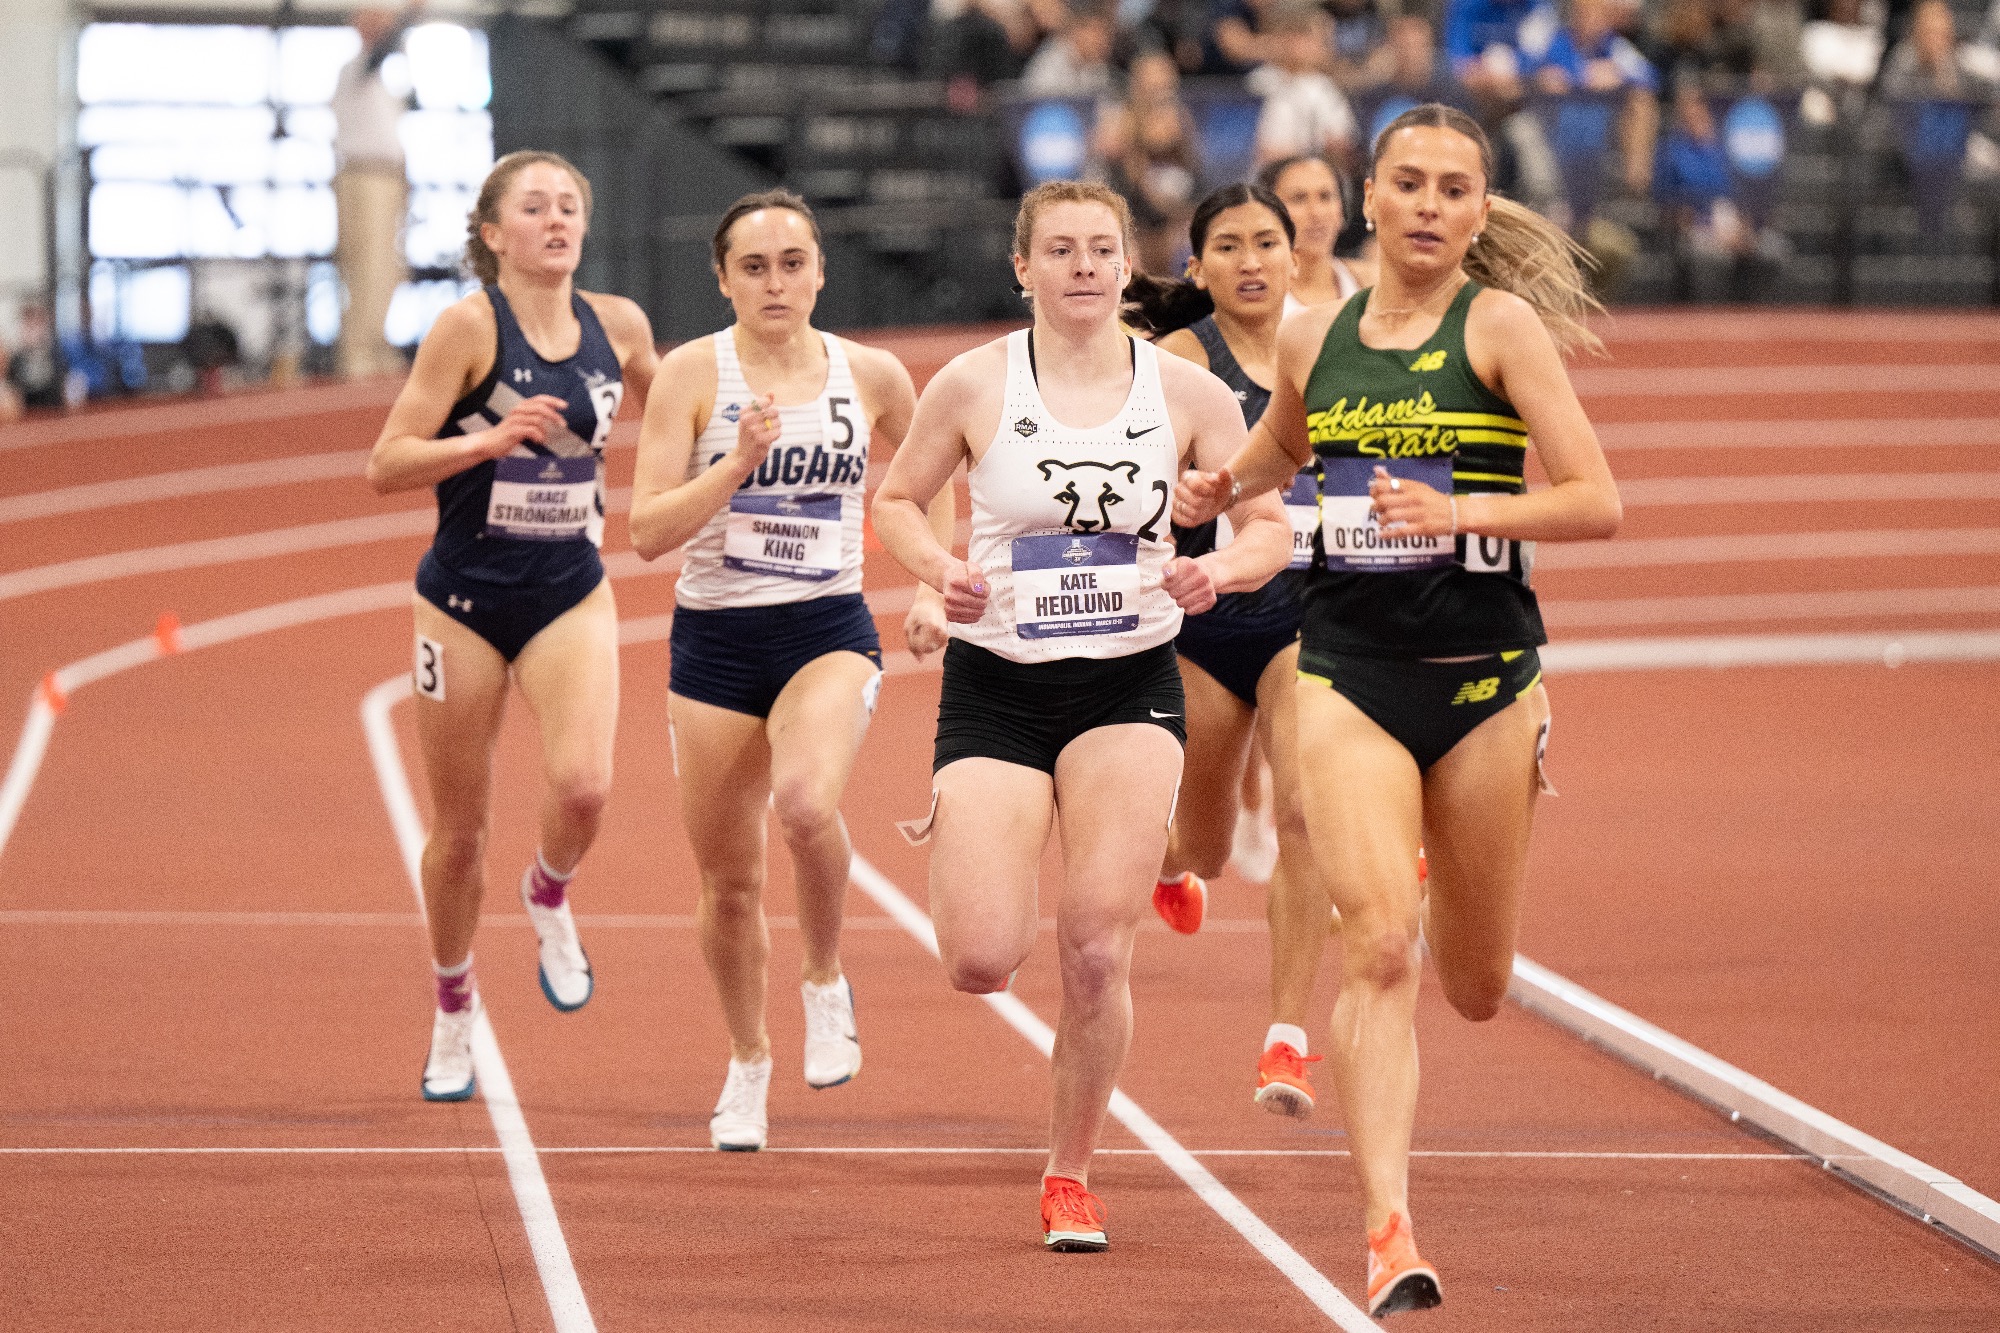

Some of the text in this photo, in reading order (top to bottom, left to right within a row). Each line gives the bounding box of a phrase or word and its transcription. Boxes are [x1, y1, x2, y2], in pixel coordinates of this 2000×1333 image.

[829, 397, 853, 450] 5
[1316, 390, 1437, 438] Adams
[1358, 424, 1458, 460] State
[709, 444, 867, 489] UGARS
[526, 490, 568, 504] GRACE
[493, 503, 588, 523] STRONGMAN
[1137, 479, 1168, 543] 2
[752, 520, 820, 540] SHANNON
[1293, 531, 1315, 549] RA
[1336, 527, 1438, 549] O'CONNOR
[763, 539, 805, 561] KING
[1060, 572, 1097, 591] KATE
[1036, 591, 1123, 617] HEDLUND
[422, 641, 437, 693] 3
